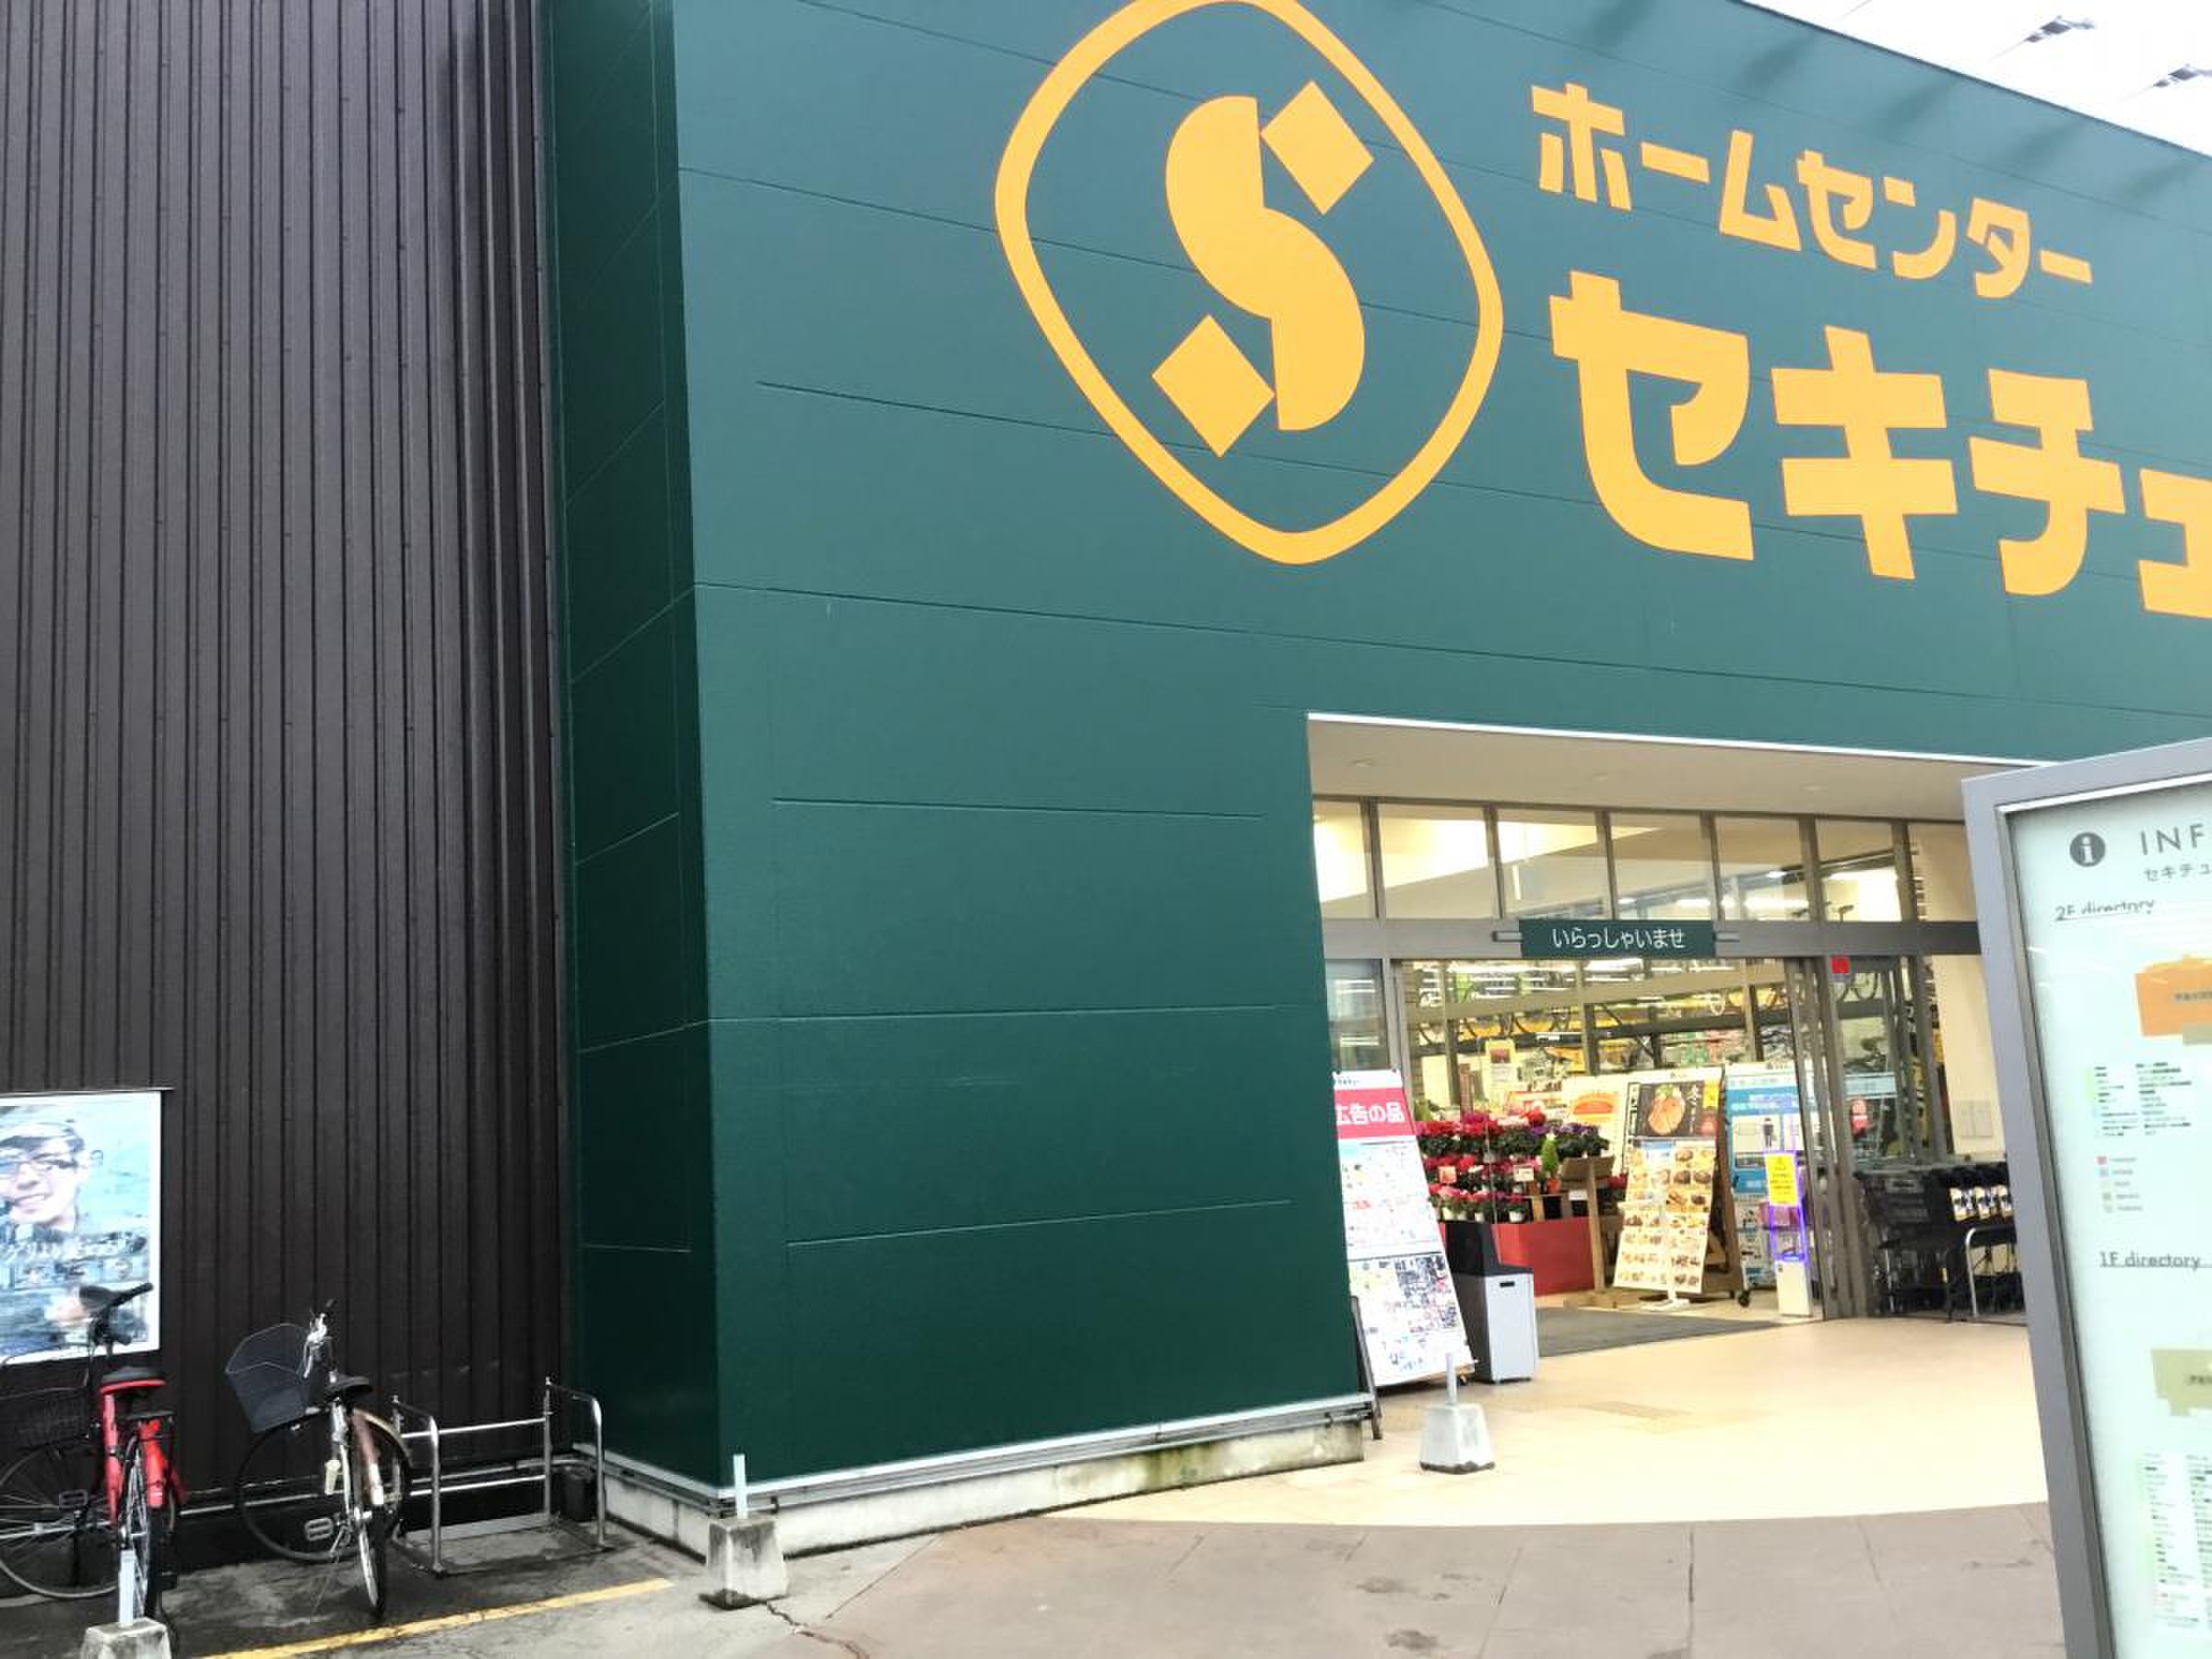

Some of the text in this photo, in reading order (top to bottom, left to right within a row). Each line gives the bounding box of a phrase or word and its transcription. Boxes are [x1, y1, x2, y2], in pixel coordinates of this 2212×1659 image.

[1530, 82, 2093, 299] ホームセンター
[2141, 823, 2204, 856] INF
[1551, 926, 1686, 949] いらっしゃいませ
[2124, 1249, 2200, 1272] directory
